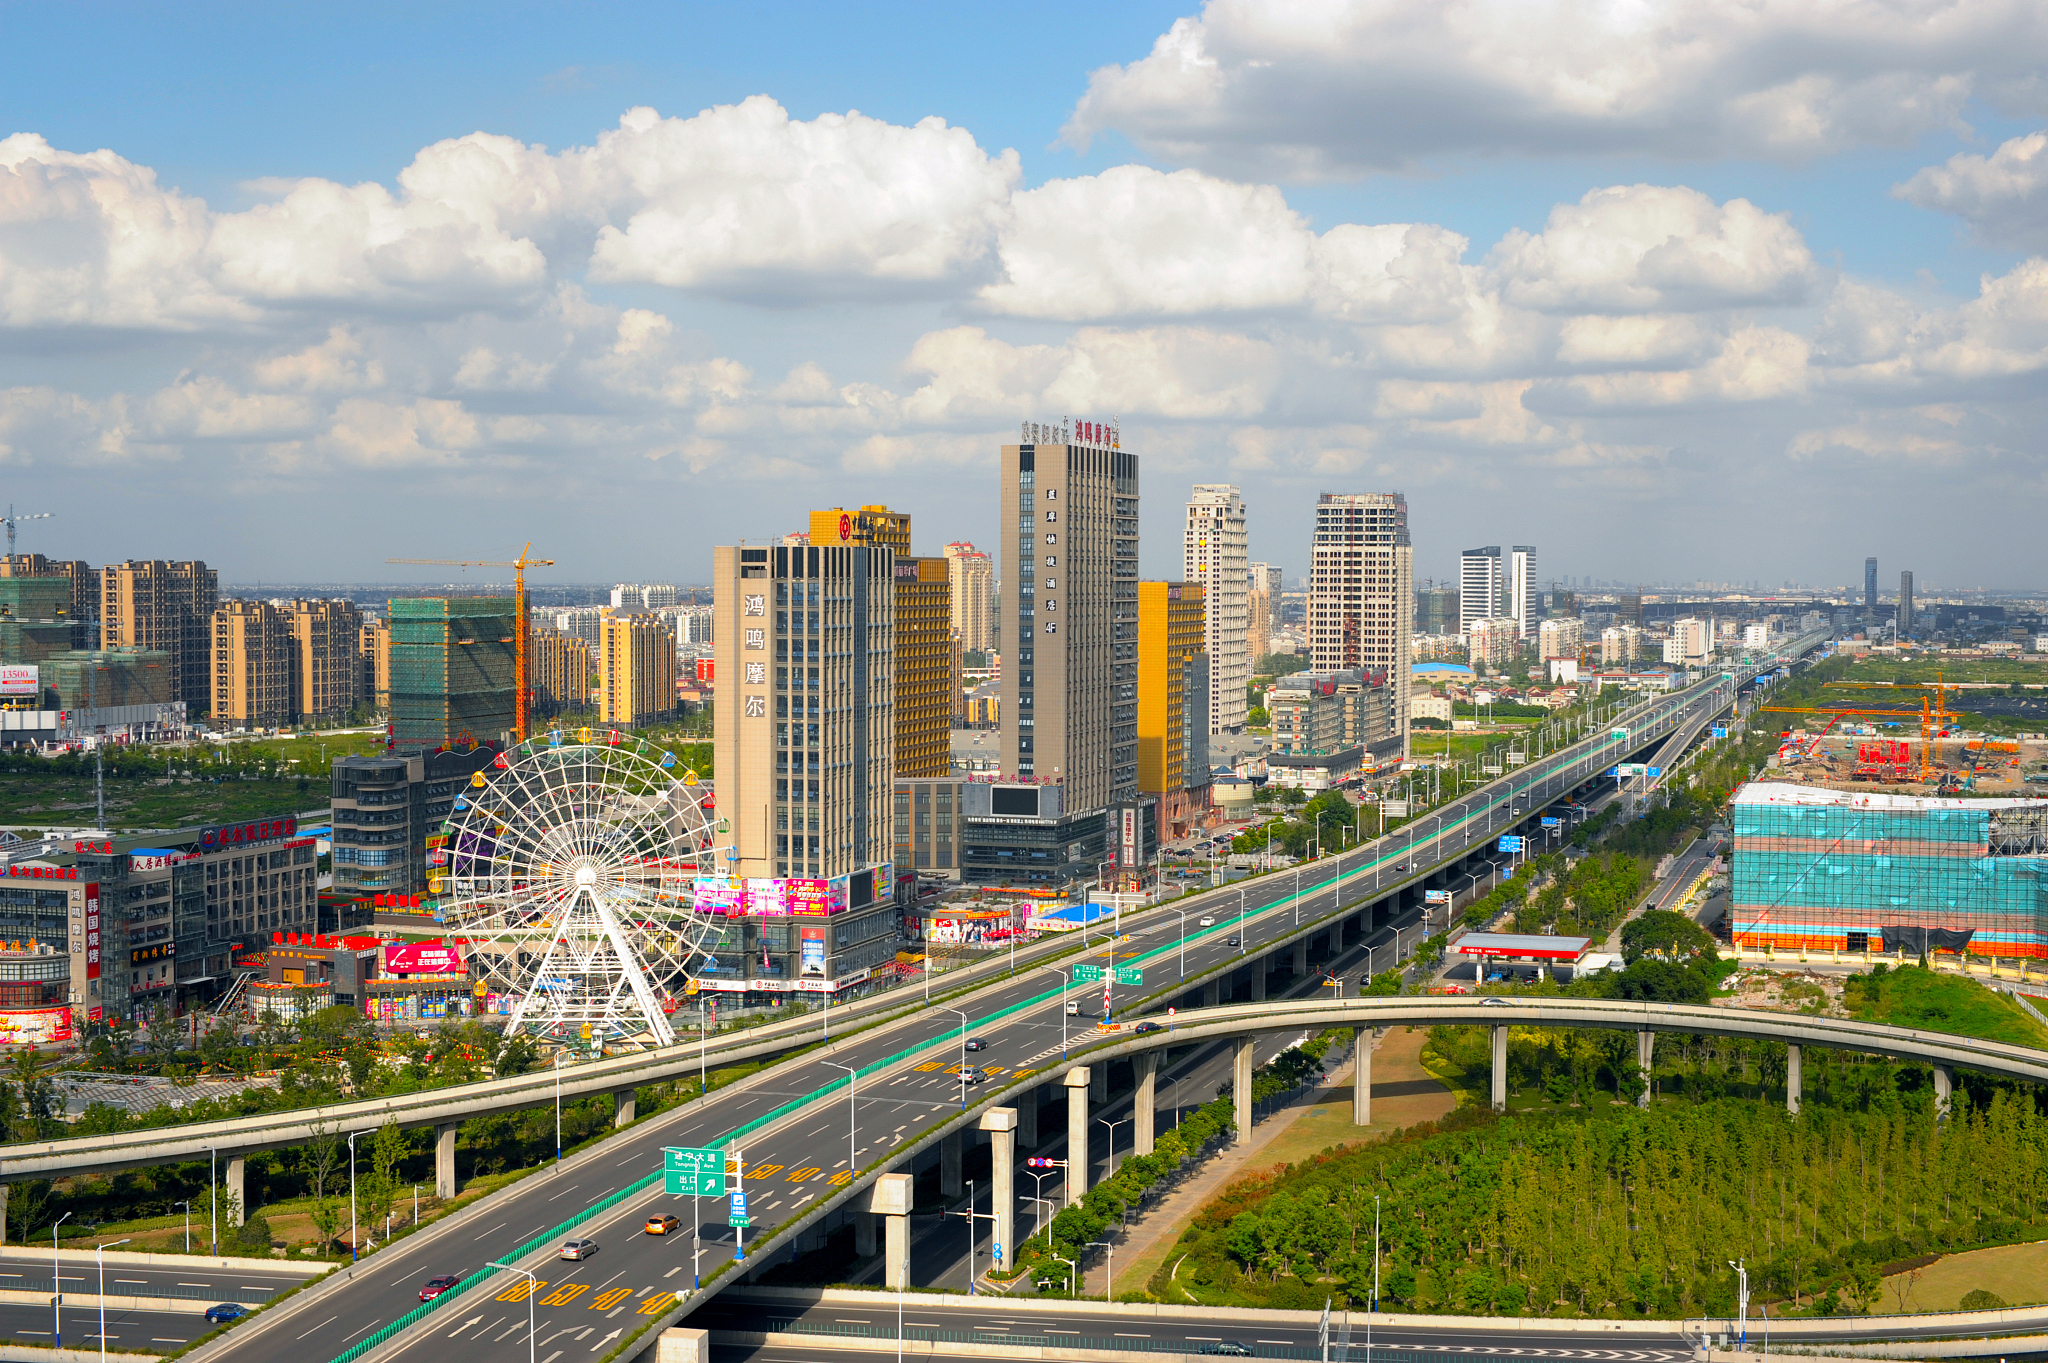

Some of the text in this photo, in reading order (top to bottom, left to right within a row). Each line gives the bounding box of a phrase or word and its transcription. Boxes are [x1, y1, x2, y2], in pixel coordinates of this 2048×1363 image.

[1046, 622, 1057, 633] 4F
[745, 595, 765, 717] 鸿鸣摩尔
[2, 670, 28, 678] 13500
[218, 818, 295, 847] 摩尔假日酒店
[75, 840, 113, 854] 能人居
[9, 865, 78, 879] 摩尔假日酒店
[71, 889, 82, 953] 鸿鸣摩尔
[938, 919, 950, 927] KFC
[87, 898, 99, 963] 韩国烧烤
[913, 1062, 945, 1072] 80
[674, 1152, 716, 1163] 通宁大道
[680, 1175, 697, 1184] 出口
[743, 1164, 784, 1179] 60
[785, 1167, 821, 1183] 40
[826, 1169, 861, 1185] 40
[495, 1279, 677, 1315] 80 60 40 40
